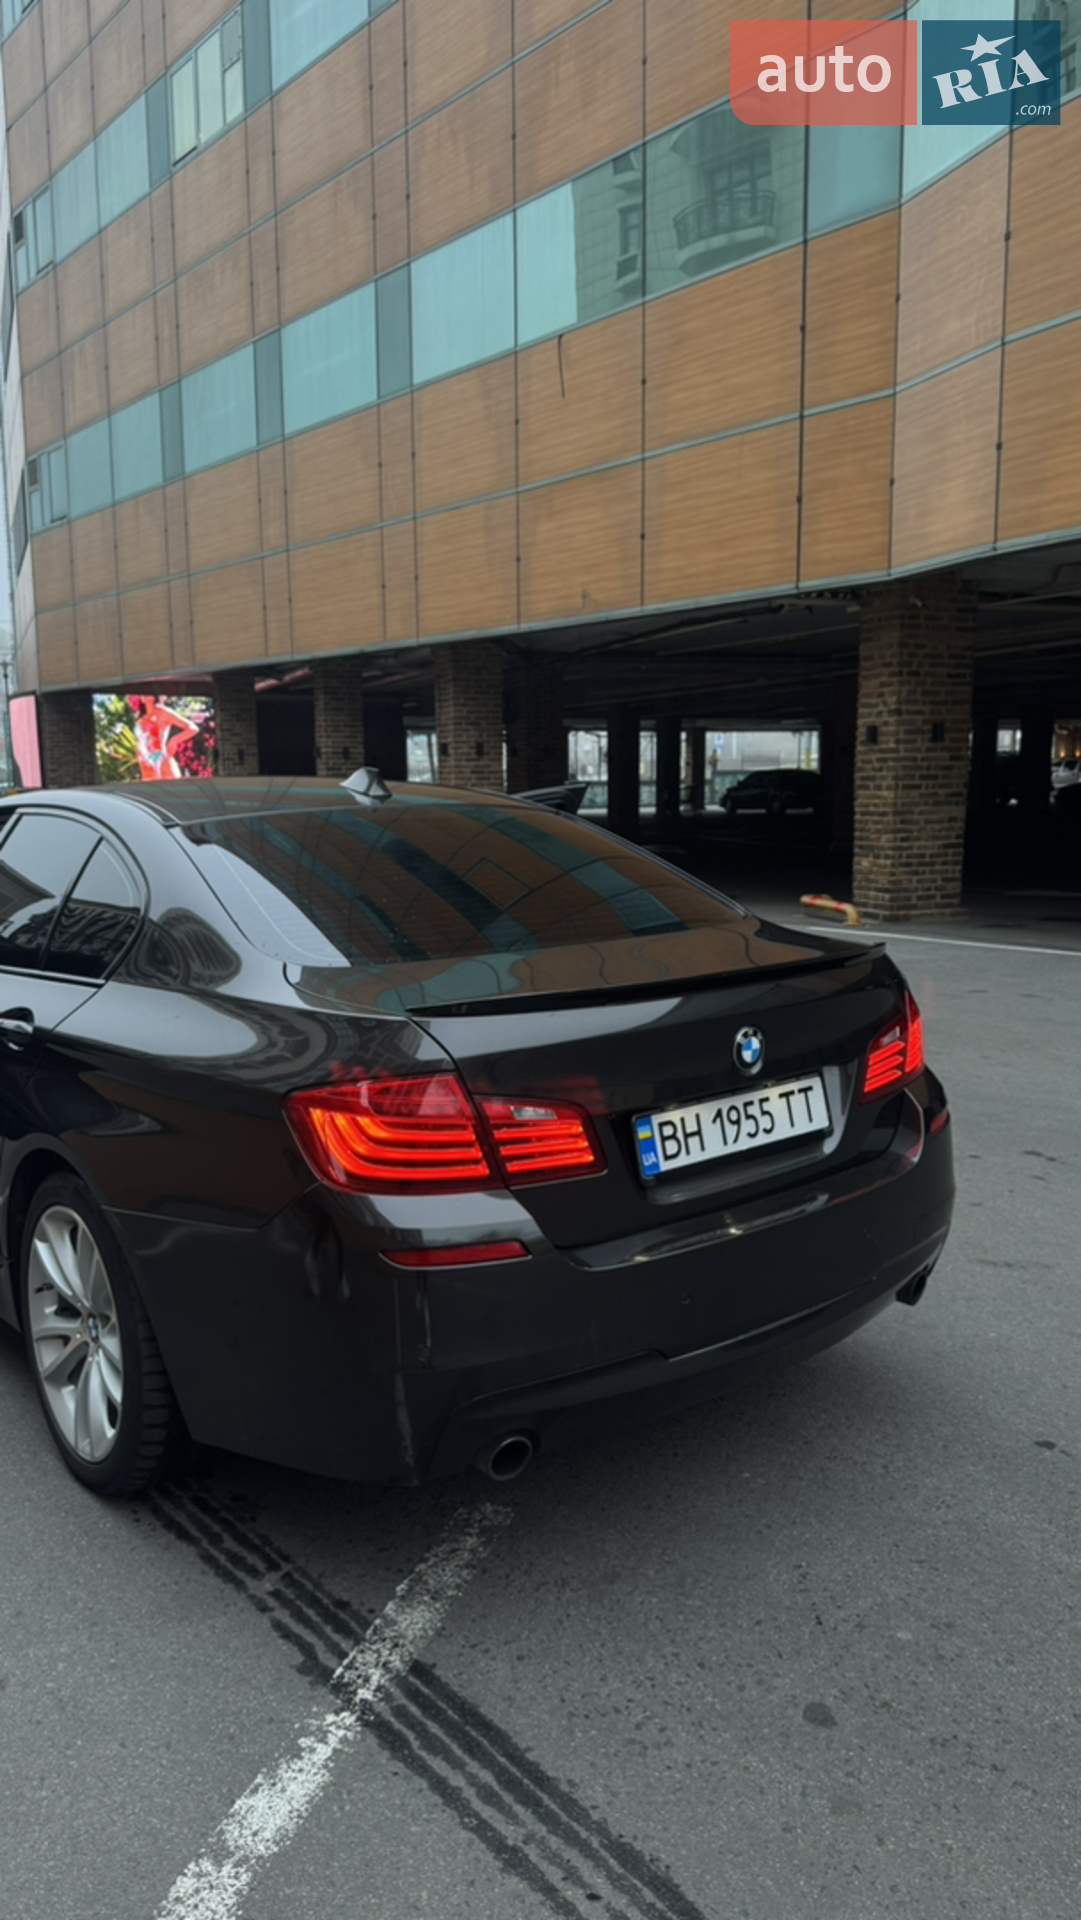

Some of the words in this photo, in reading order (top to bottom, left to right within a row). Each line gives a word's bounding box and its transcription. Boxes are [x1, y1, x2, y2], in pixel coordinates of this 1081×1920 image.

[658, 1113, 705, 1161] BH
[712, 1096, 775, 1147] 1955
[778, 1086, 813, 1128] TT
[642, 1152, 657, 1166] UA
